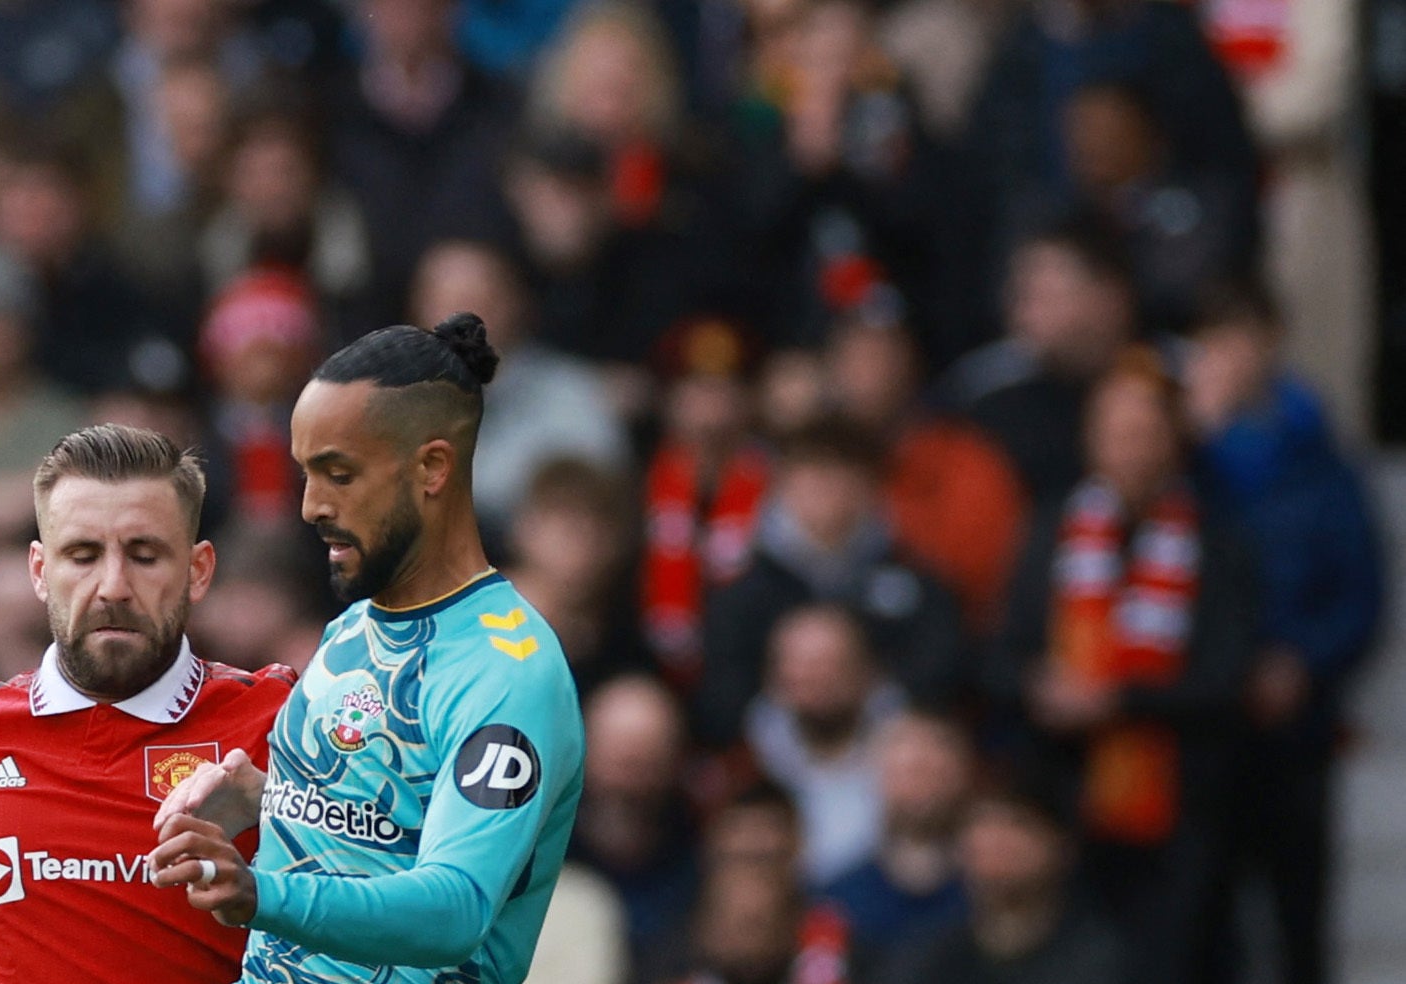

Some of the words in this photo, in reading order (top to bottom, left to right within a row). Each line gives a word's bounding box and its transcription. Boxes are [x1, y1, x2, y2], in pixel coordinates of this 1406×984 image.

[461, 742, 533, 790] JD
[262, 784, 402, 841] ortsbet.io
[23, 851, 153, 883] TeamVi
